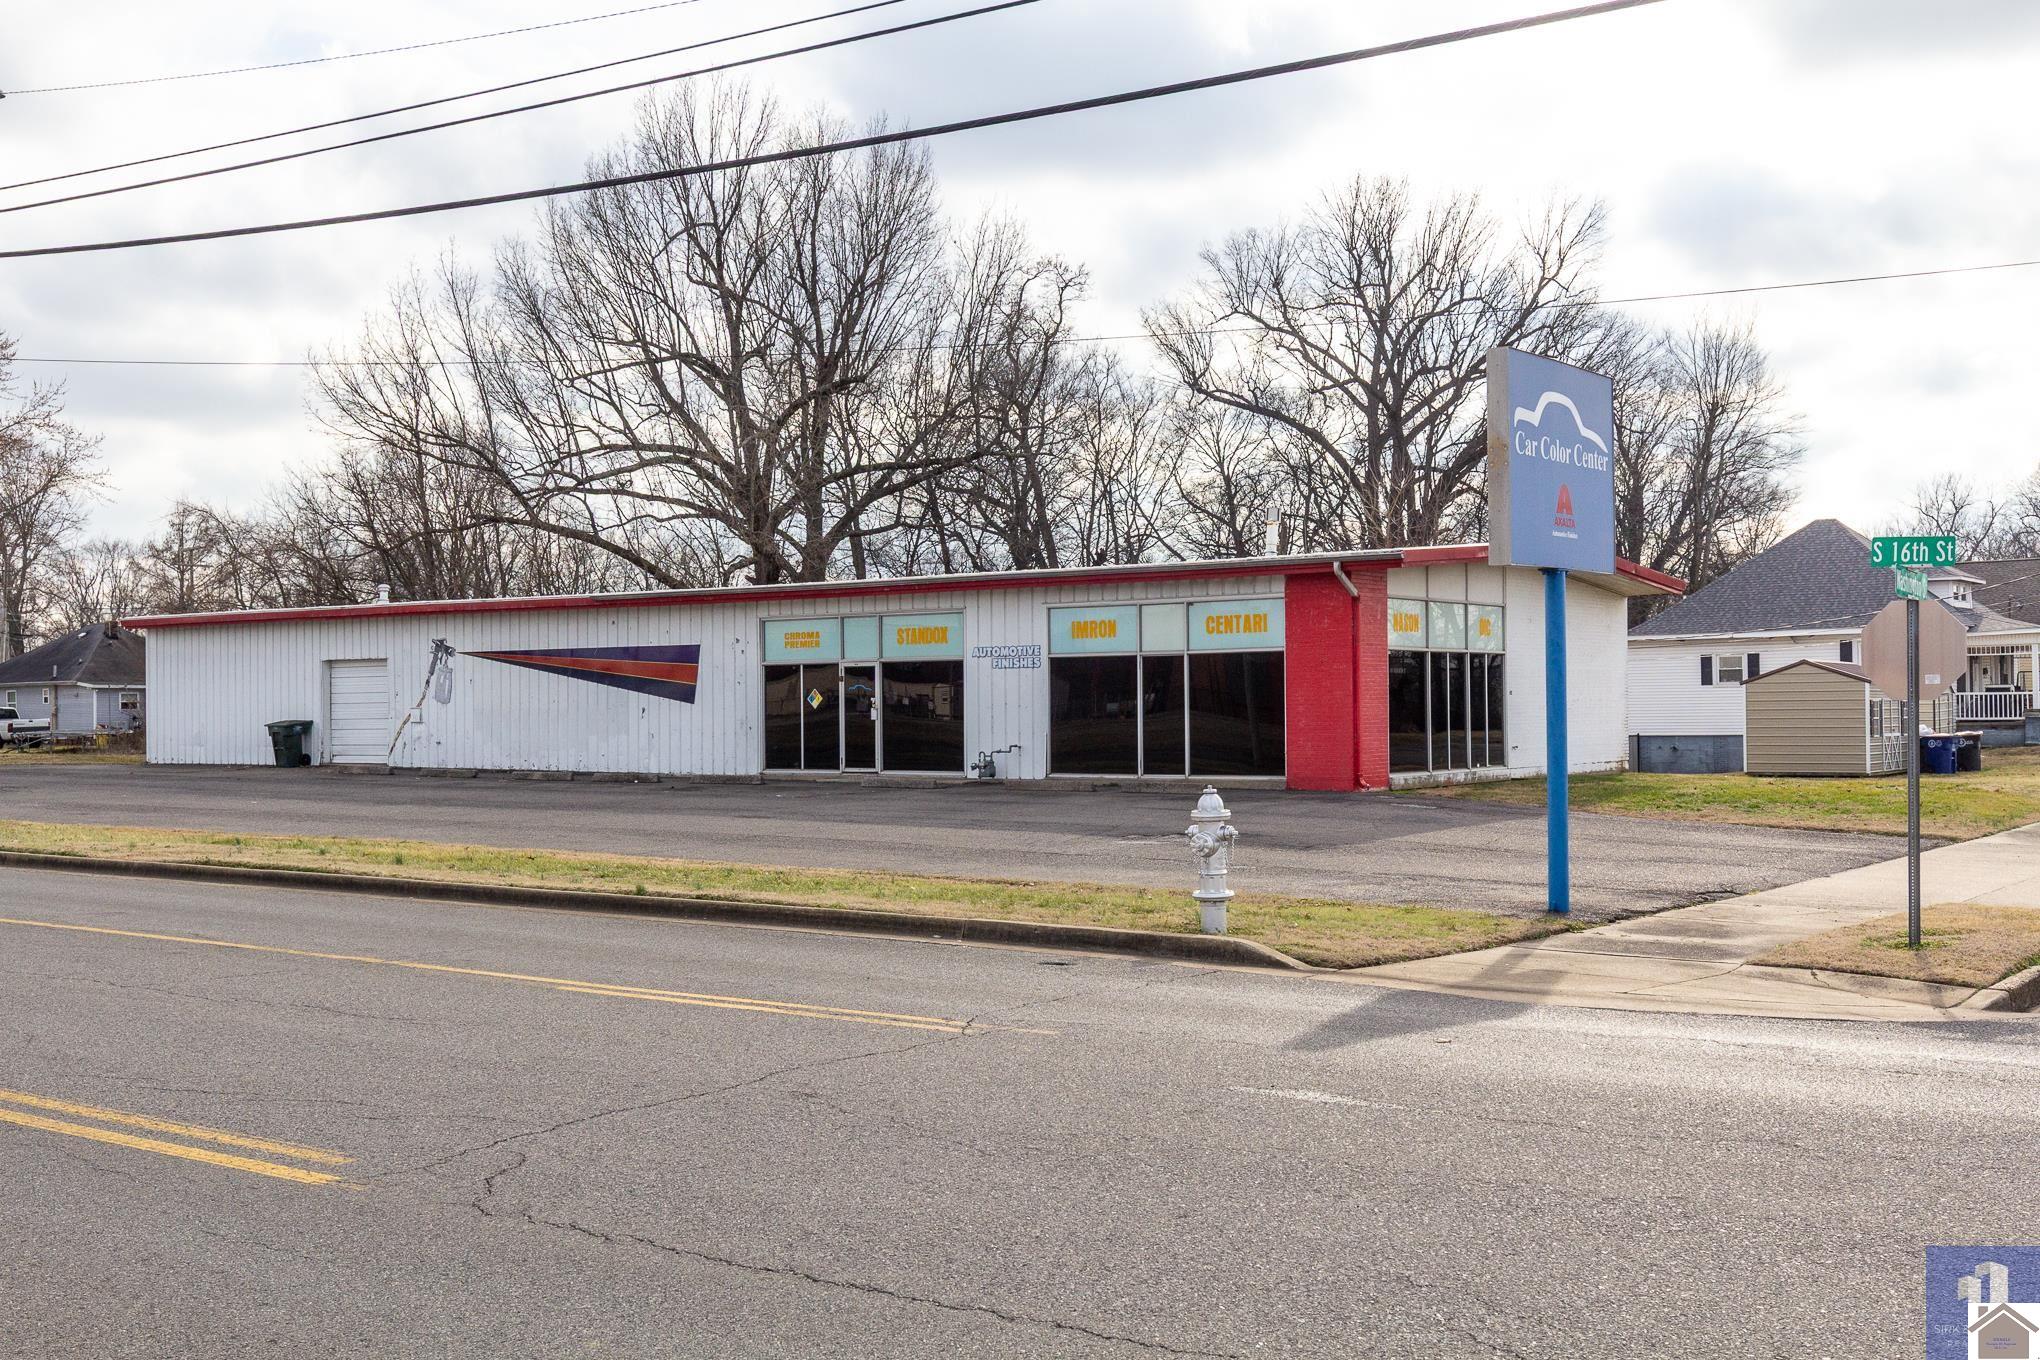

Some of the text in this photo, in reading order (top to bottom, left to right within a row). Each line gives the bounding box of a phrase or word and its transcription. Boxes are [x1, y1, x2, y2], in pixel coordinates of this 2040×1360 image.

[1515, 431, 1608, 472] Car Color Center
[1873, 540, 1954, 562] S 16th St
[1071, 619, 1117, 640] IMRON
[1205, 613, 1268, 635] CENTARI
[784, 631, 821, 640] CHROMA
[784, 640, 821, 648] PREMIER
[896, 626, 948, 646] STANDOX
[972, 645, 1041, 658] AUTOMOTIVE
[992, 657, 1041, 669] FINISHES
